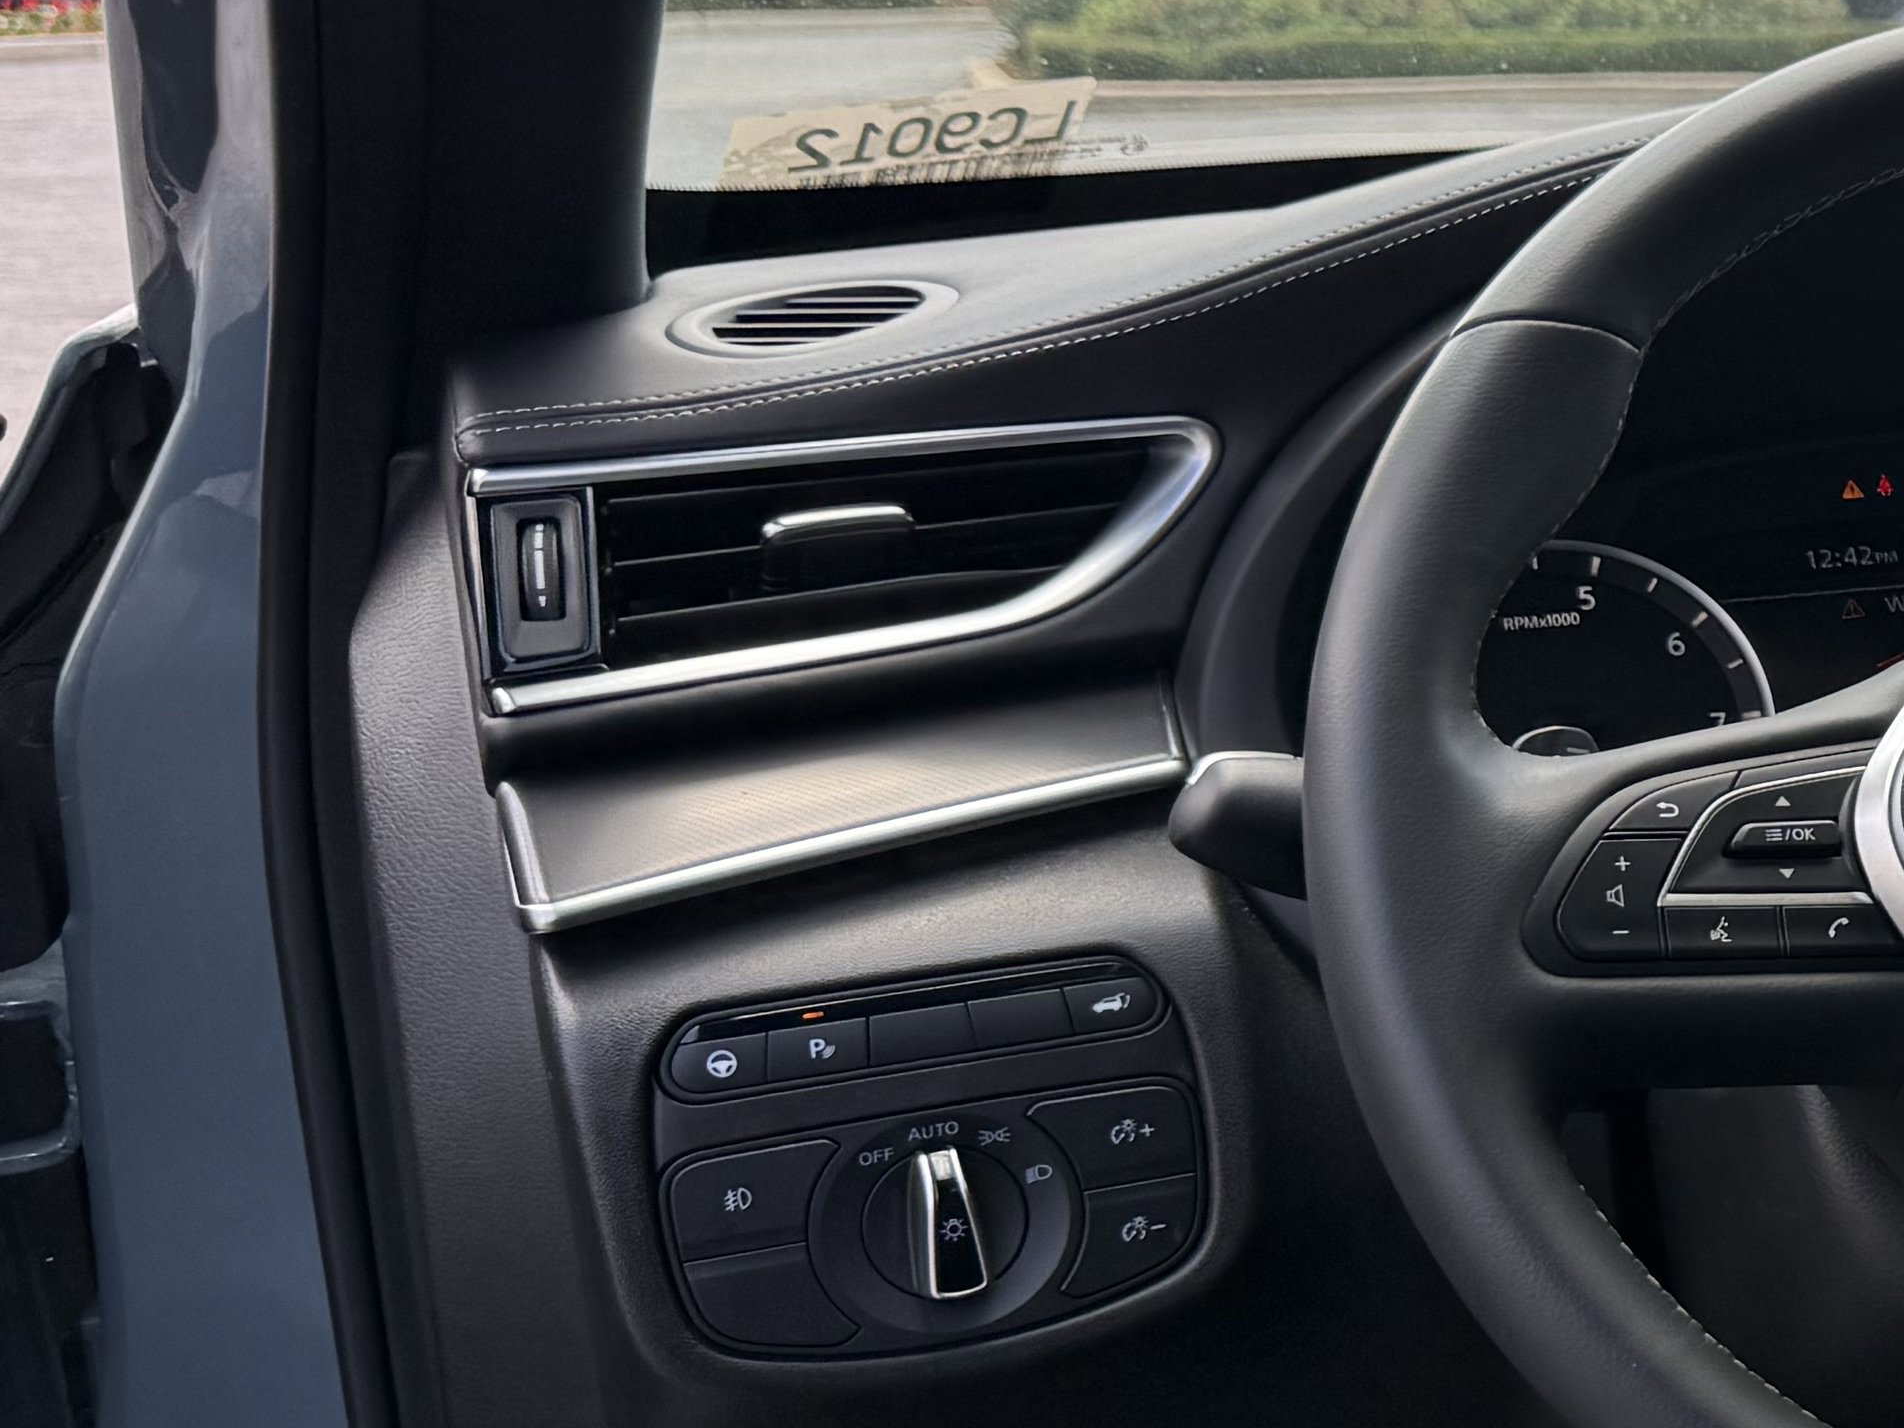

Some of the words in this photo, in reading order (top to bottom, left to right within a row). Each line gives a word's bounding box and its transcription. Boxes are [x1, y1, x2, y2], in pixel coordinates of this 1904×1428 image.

[1576, 585, 1597, 611] 5
[1667, 631, 1687, 656] 6
[908, 1121, 960, 1141] AUTO
[858, 1147, 894, 1167] OFF
